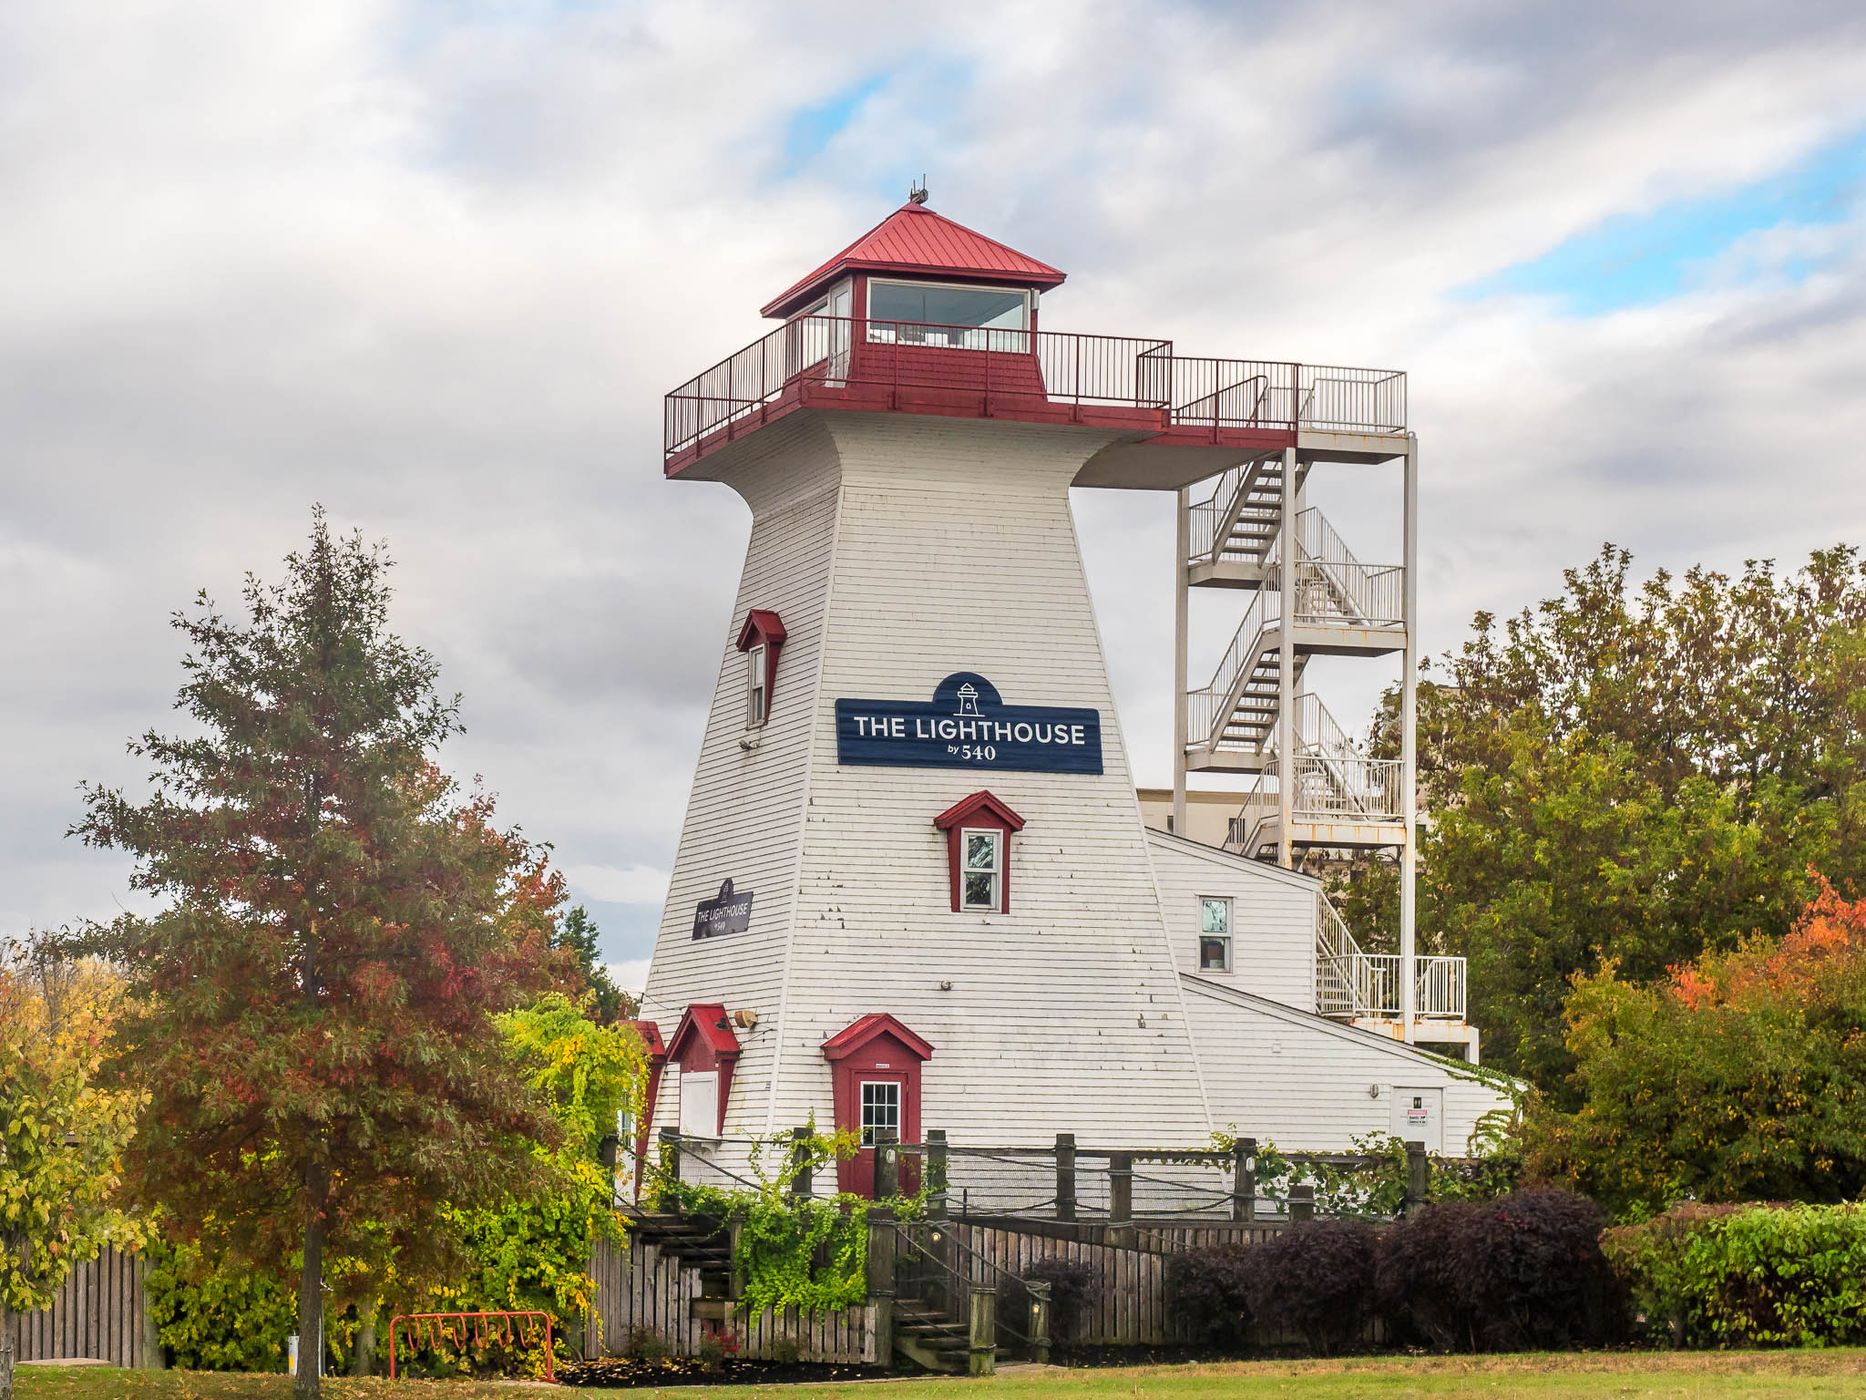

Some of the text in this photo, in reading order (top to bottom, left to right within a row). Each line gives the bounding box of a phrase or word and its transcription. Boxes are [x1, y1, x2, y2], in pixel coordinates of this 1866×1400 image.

[853, 716, 1085, 745] THE LIGHTHOUSE
[947, 744, 996, 760] by 540
[698, 903, 749, 923] THE LIGHTHOUSE
